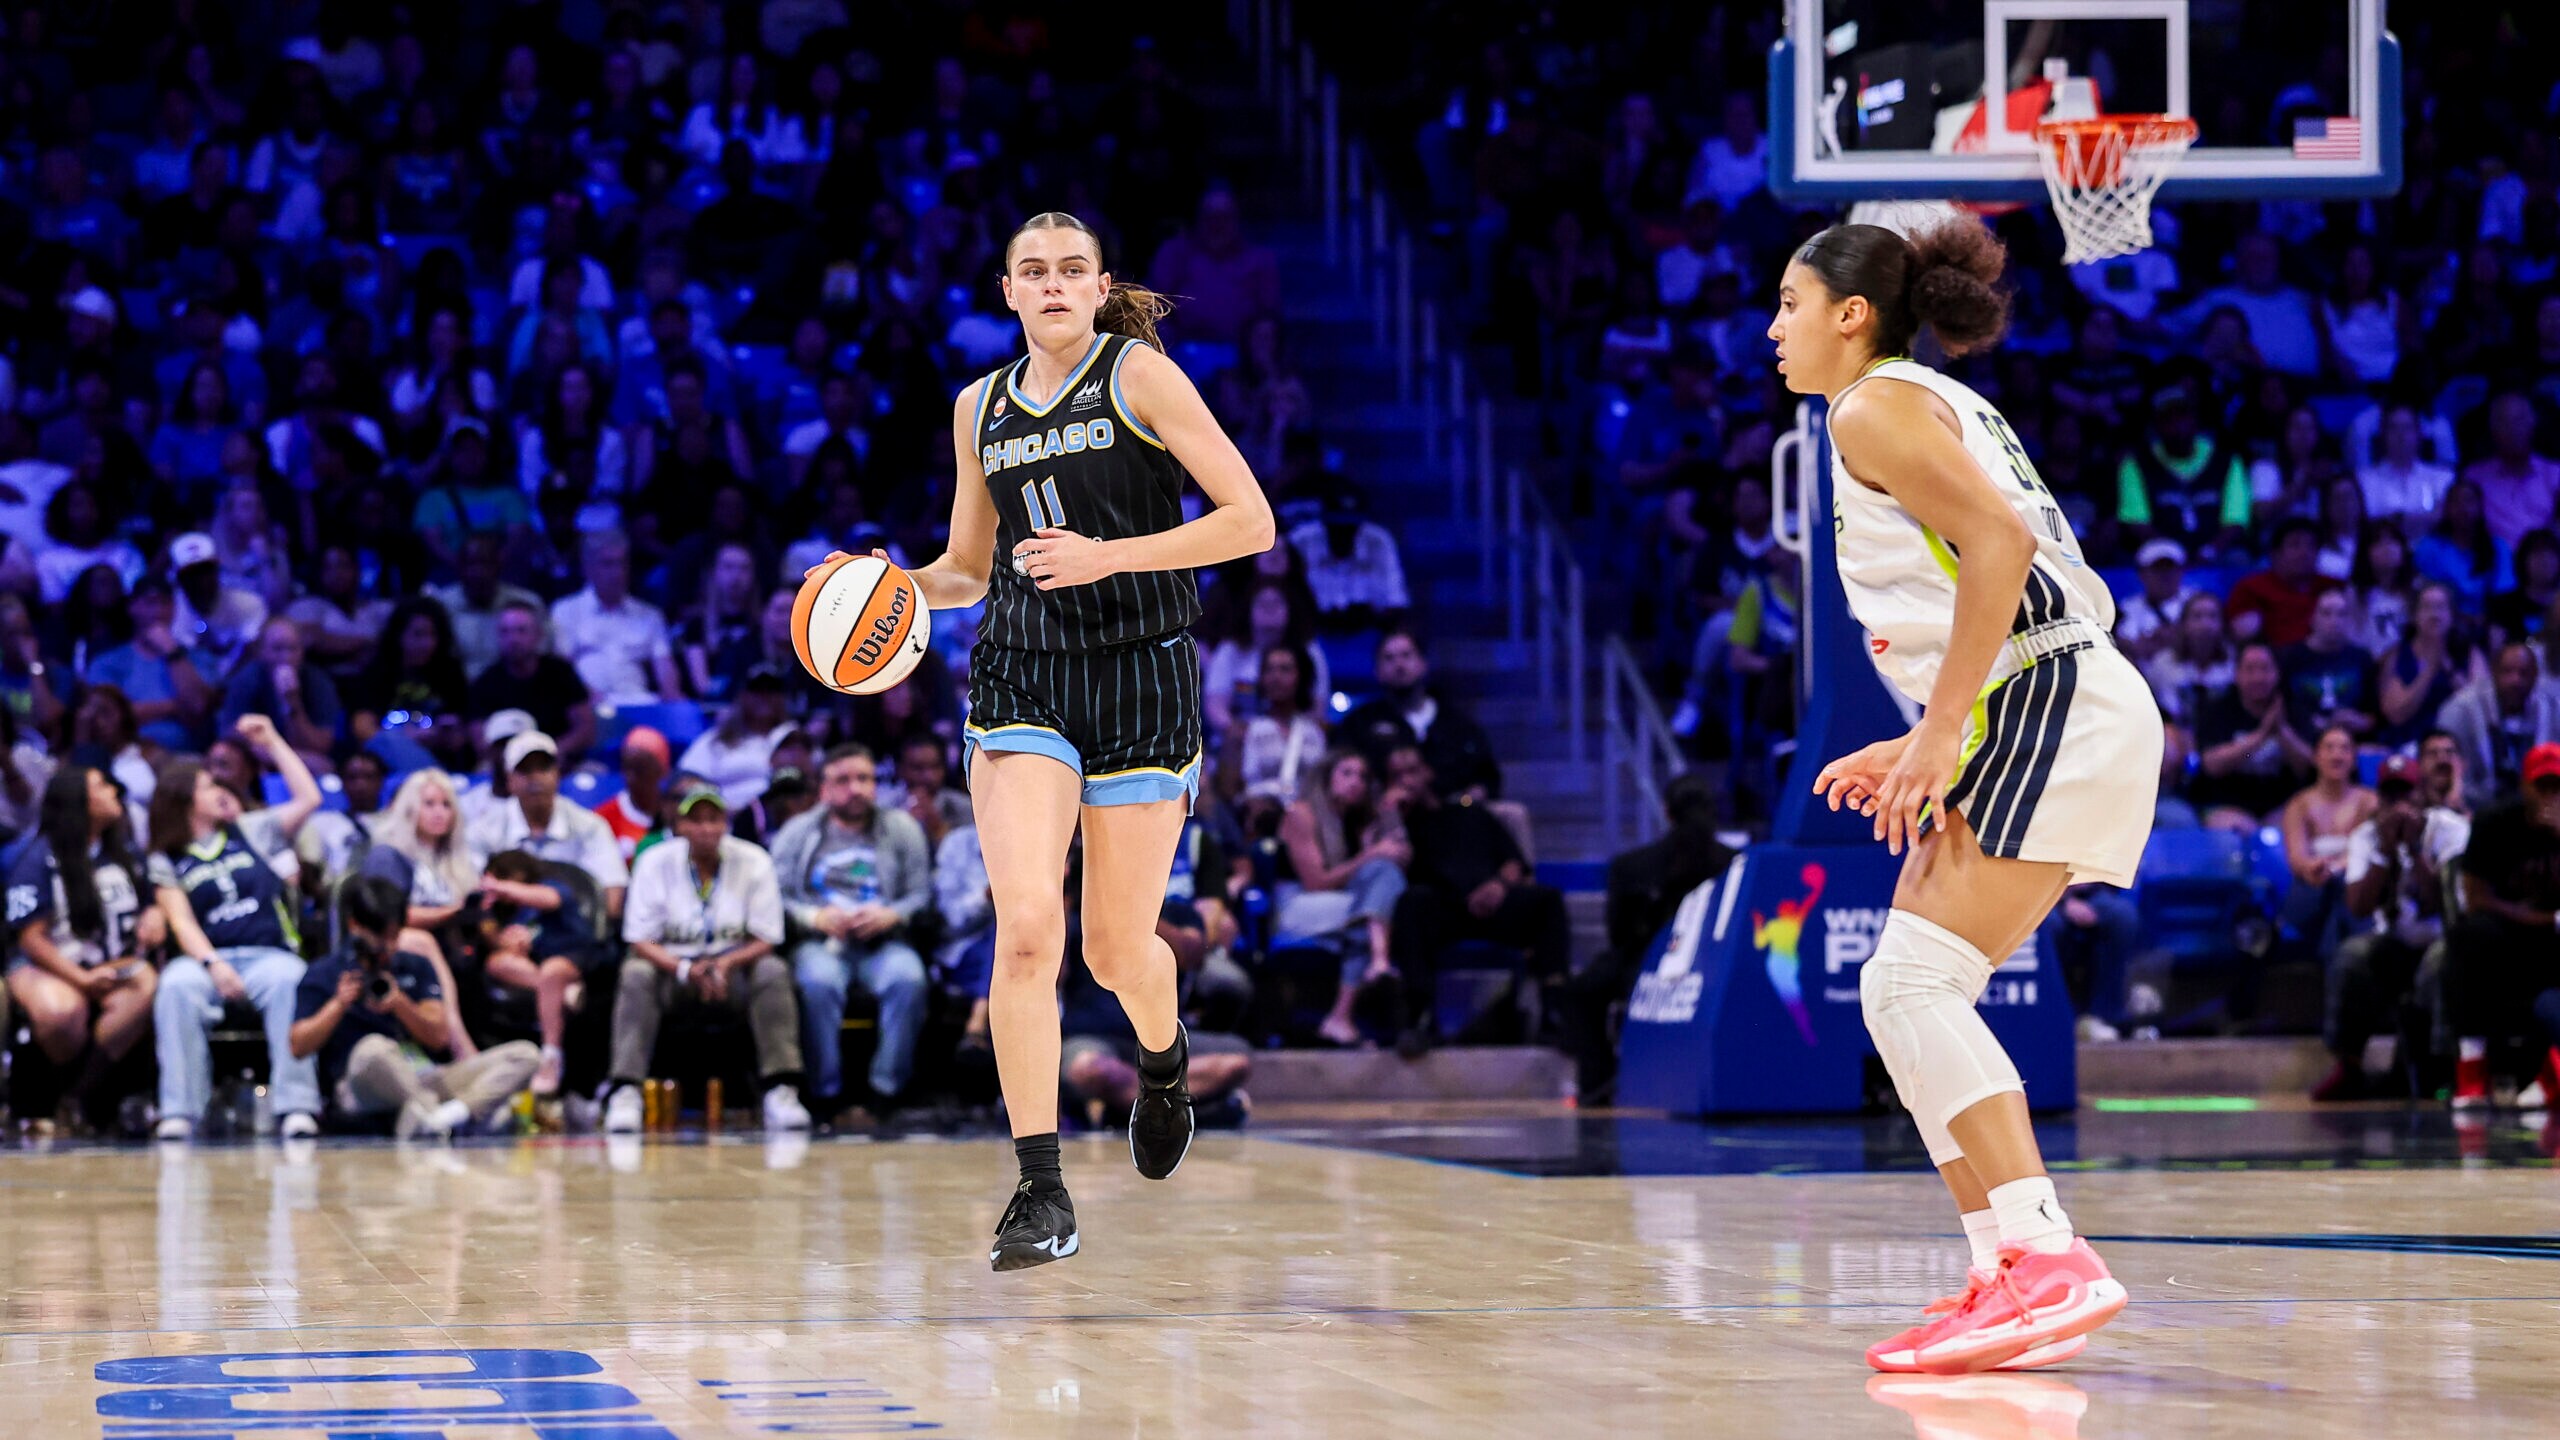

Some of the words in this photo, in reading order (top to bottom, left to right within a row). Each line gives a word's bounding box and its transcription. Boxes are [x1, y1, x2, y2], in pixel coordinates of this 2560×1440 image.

[982, 417, 1115, 477] CHICAGO
[1975, 410, 2050, 496] 35
[1021, 474, 1066, 533] 11
[851, 586, 909, 667] Wilson
[1823, 907, 1889, 935] WN
[698, 1379, 943, 1440] OURT
